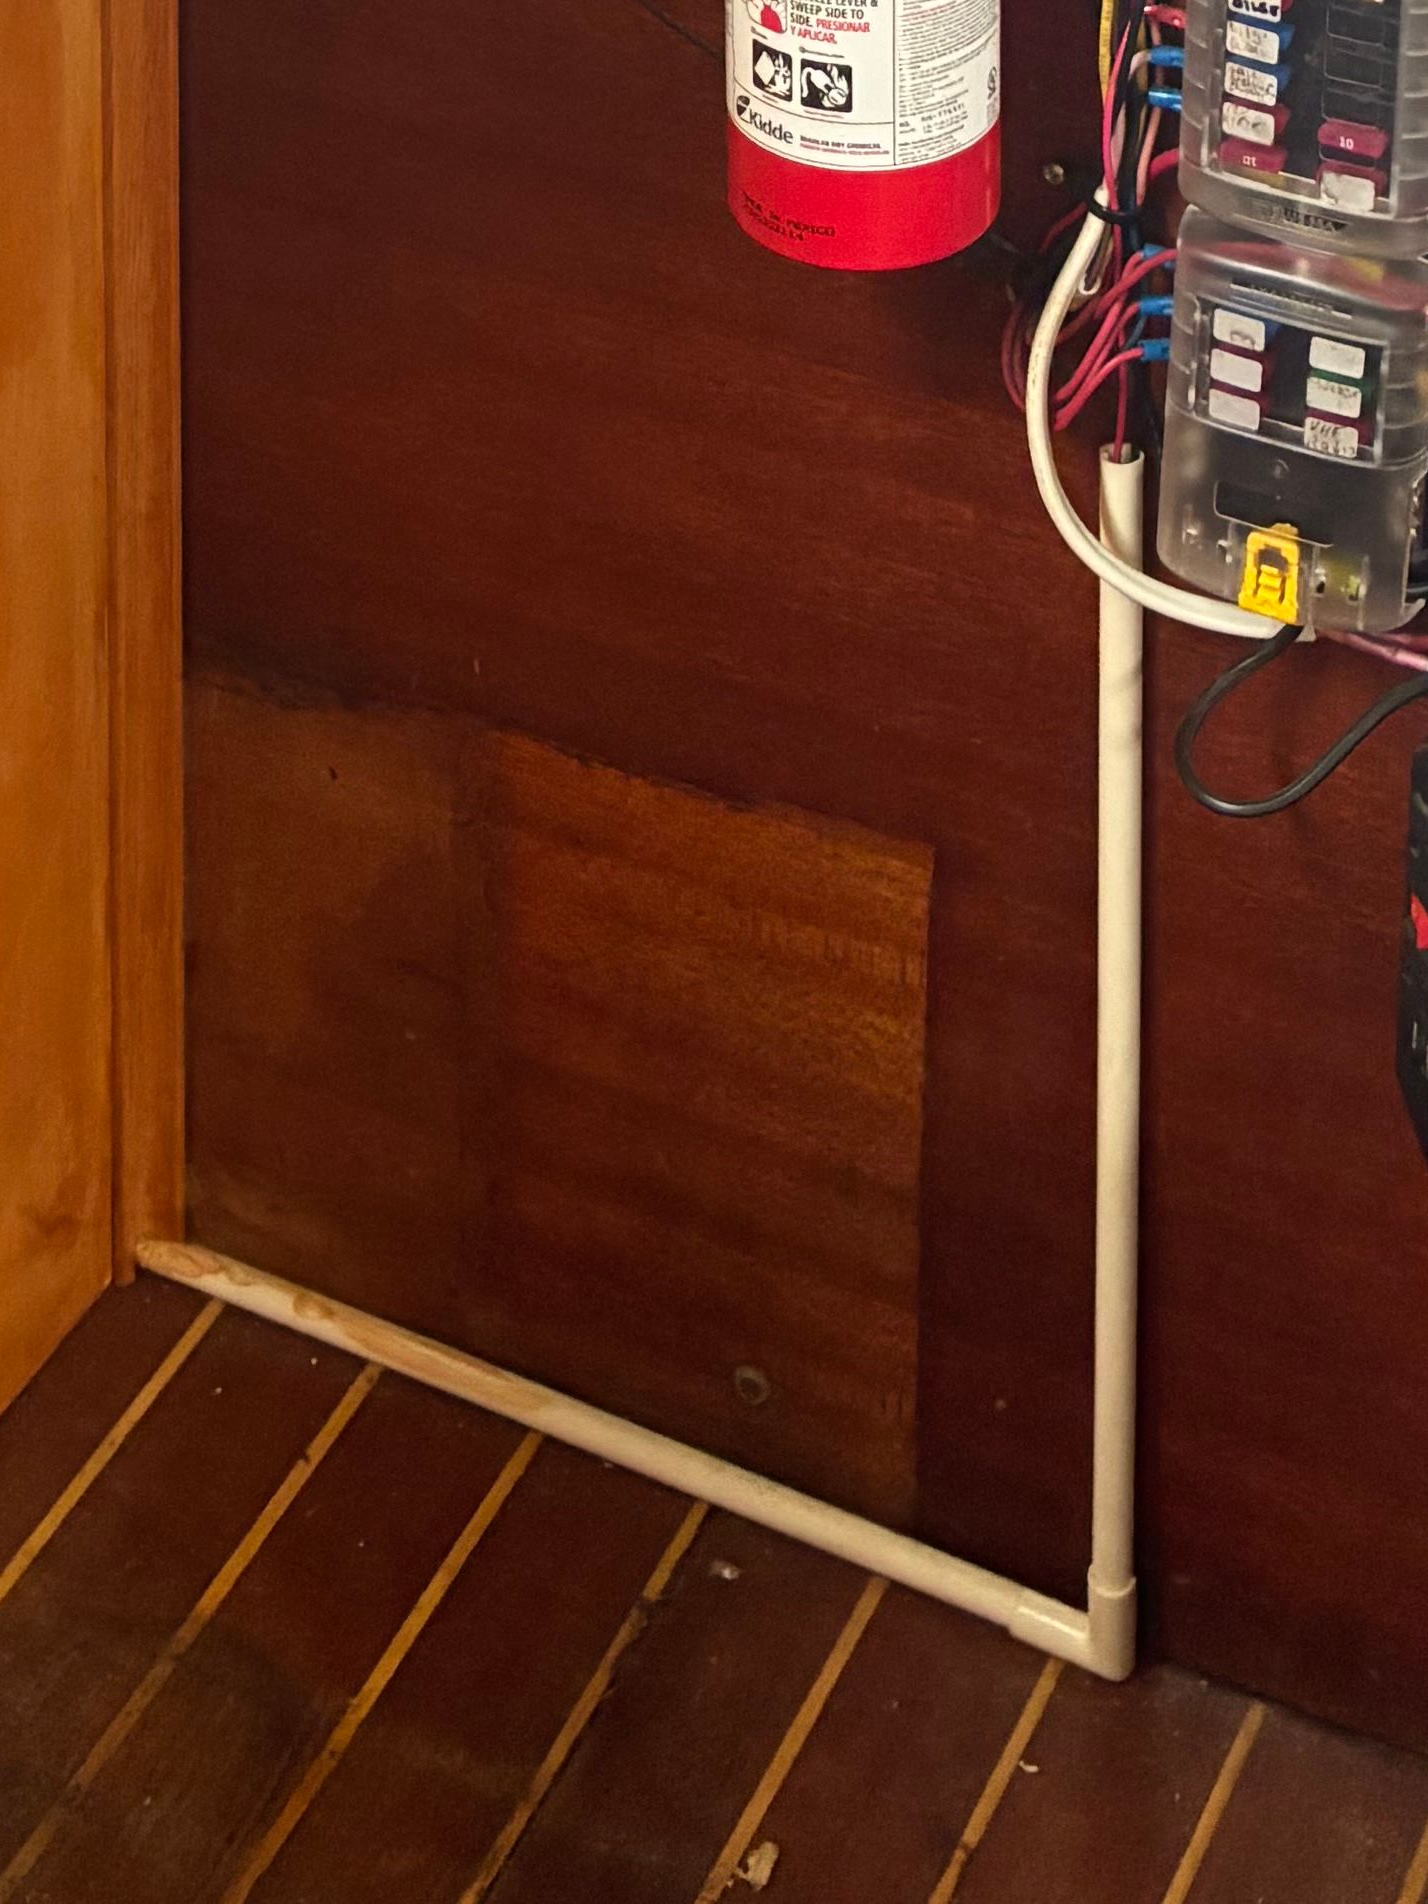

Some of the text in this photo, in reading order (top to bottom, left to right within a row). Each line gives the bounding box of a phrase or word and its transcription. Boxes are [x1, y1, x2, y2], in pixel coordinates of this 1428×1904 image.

[790, 0, 865, 20] SWEEP SIDE TO
[790, 13, 871, 33] SIDE. PRESIONAR
[790, 24, 796, 36] Y
[747, 107, 795, 145] Kidde
[1339, 135, 1355, 151] 10
